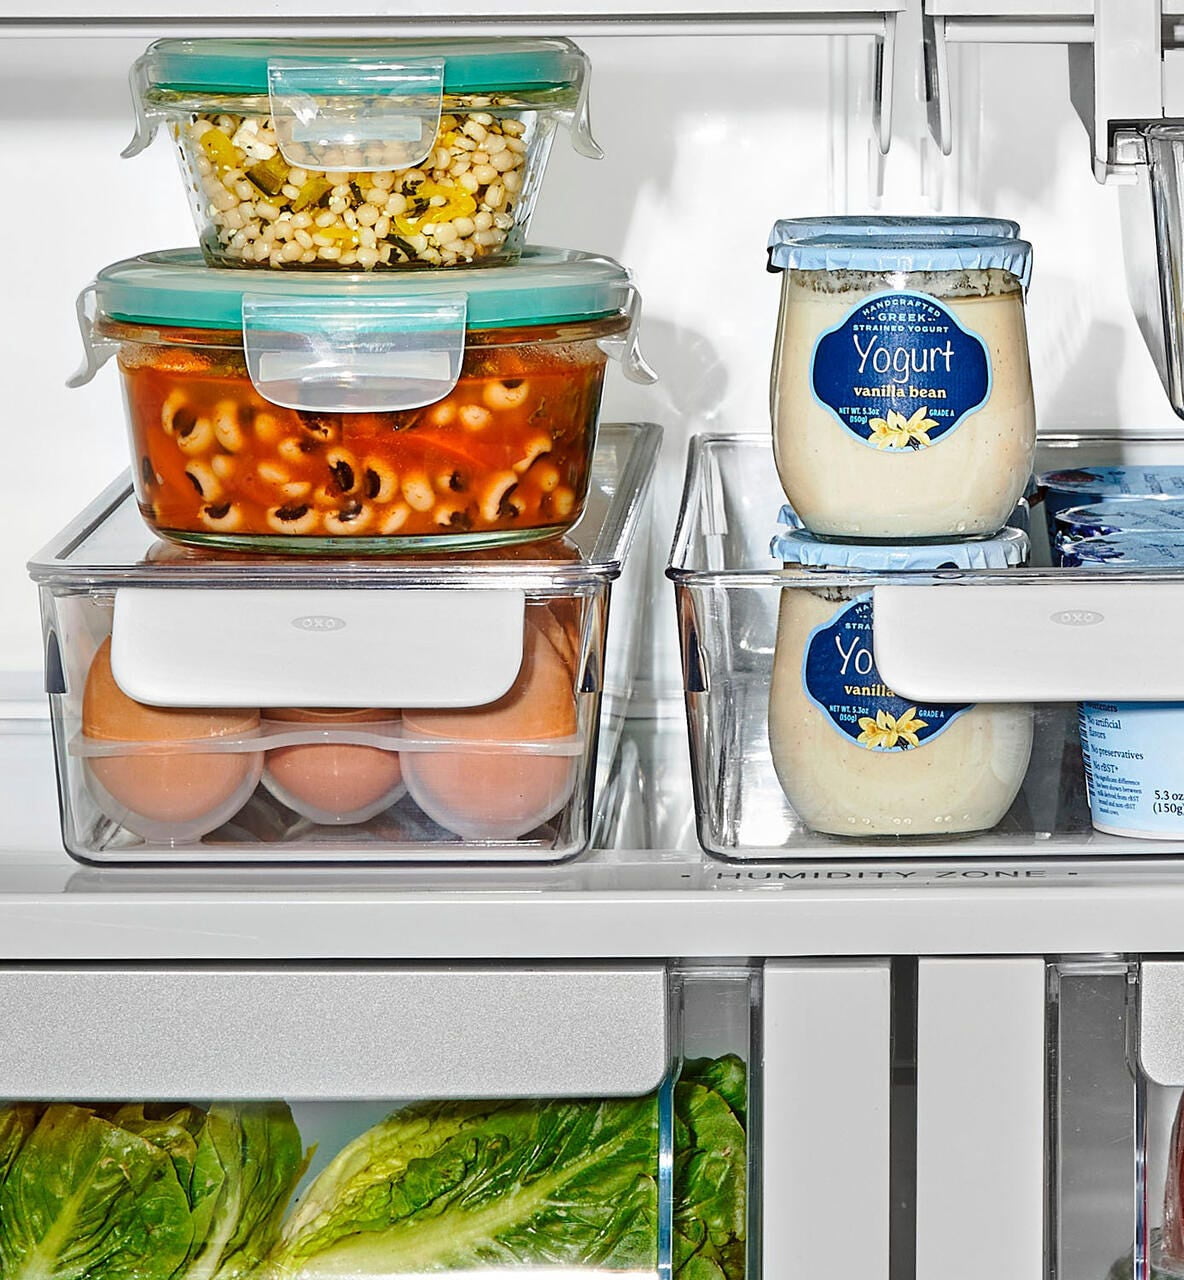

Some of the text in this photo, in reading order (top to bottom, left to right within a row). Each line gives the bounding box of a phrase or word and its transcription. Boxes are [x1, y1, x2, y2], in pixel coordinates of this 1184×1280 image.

[862, 298, 941, 318] HANDCRAFTED
[877, 312, 927, 322] GREEK
[908, 325, 949, 333] YOGURT
[853, 333, 955, 384] Yogurt
[853, 385, 947, 399] vanilla bean
[929, 409, 955, 417] GRADE A
[1060, 612, 1094, 622] OXO
[303, 618, 335, 628] OXO
[844, 684, 896, 697] vanilla
[829, 705, 840, 713] NET
[918, 709, 945, 718] GRADE A
[1099, 749, 1144, 761] preservatives
[1154, 790, 1184, 801] 5.3 oz
[716, 870, 1048, 879] HUMIDITY ZONE
